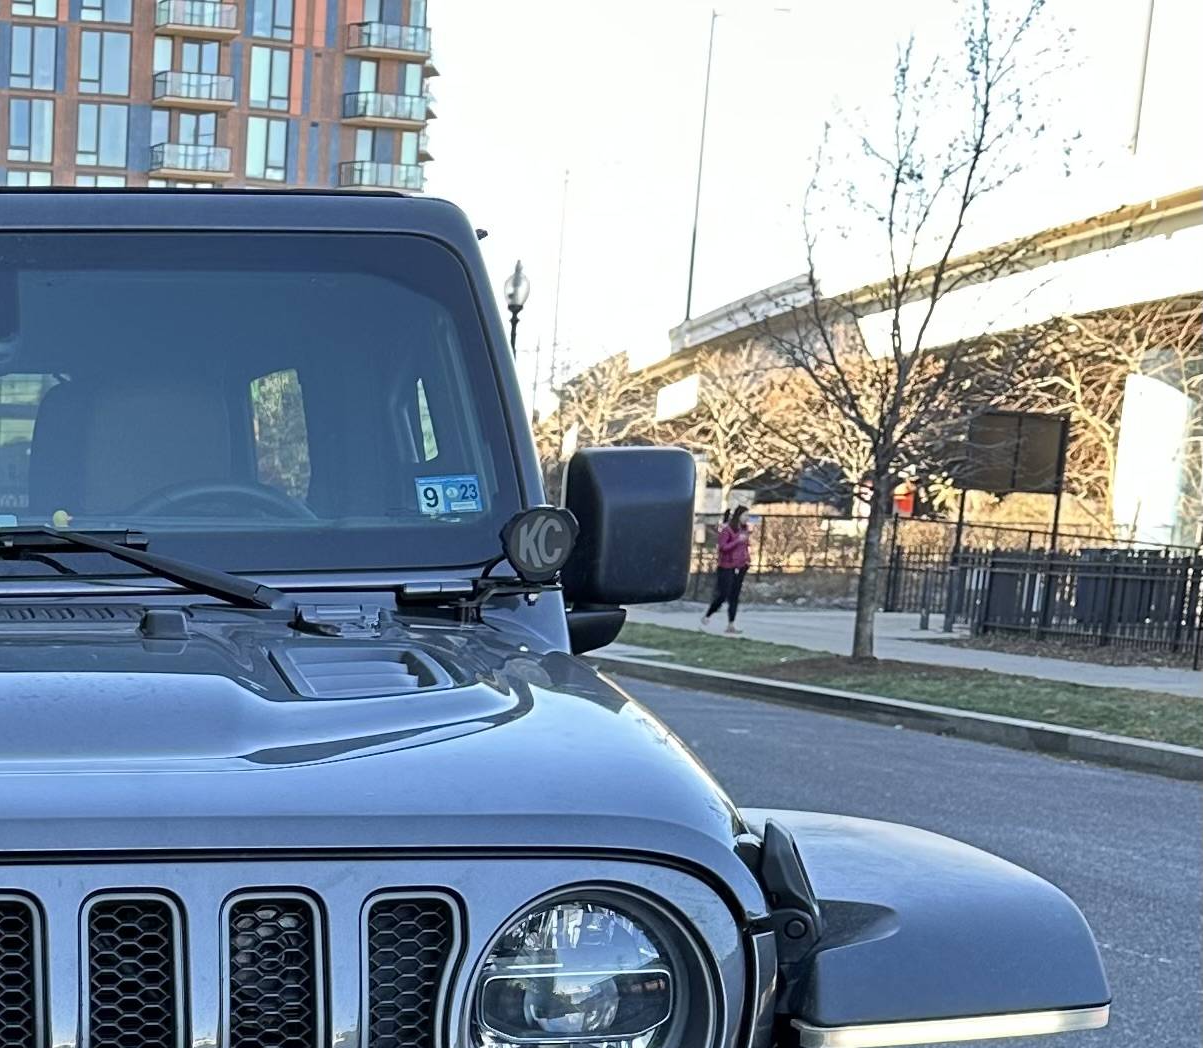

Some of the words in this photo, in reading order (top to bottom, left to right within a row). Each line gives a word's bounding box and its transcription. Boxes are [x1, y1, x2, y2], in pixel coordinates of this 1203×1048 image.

[423, 486, 439, 508] 9
[460, 484, 478, 500] 23
[518, 515, 563, 568] KC
